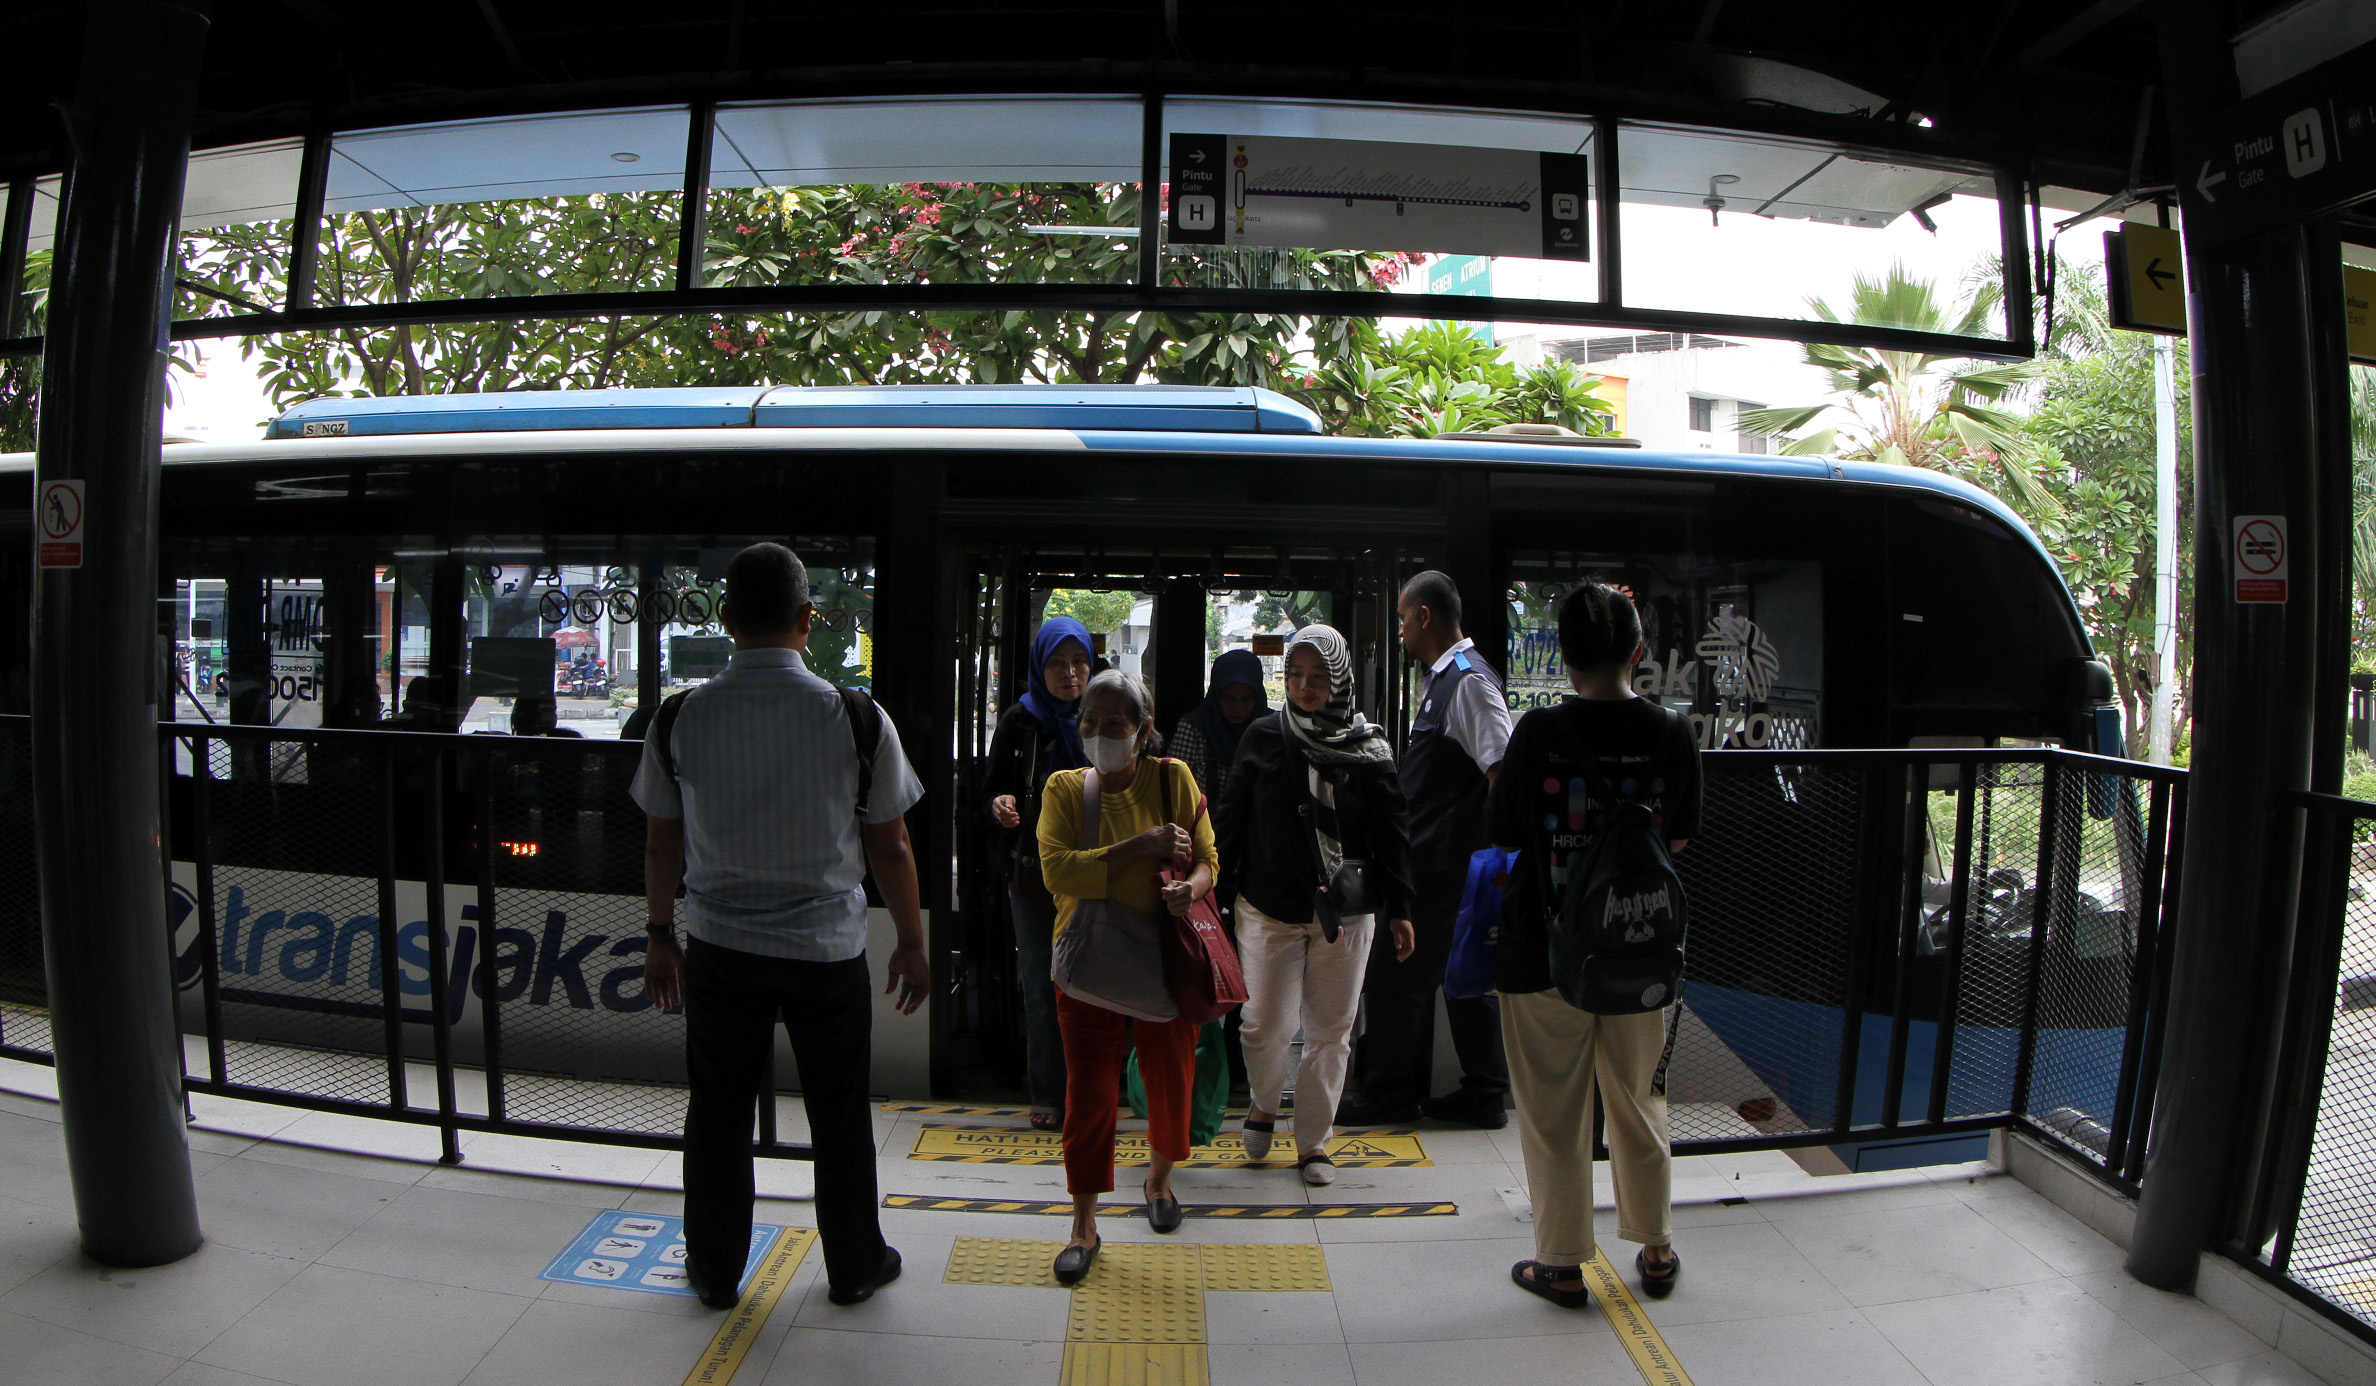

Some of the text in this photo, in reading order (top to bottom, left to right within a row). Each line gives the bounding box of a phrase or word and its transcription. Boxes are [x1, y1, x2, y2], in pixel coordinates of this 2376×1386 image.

[2233, 136, 2274, 164] Pintu
[2293, 123, 2315, 162] H
[1182, 169, 1213, 181] Pintu
[1182, 182, 1203, 192] Gate
[2237, 168, 2265, 189] Gate
[1190, 203, 1204, 221] H
[1460, 256, 1486, 284] ATRIUM
[2346, 296, 2369, 309] eluar
[2348, 311, 2366, 326] Exit
[306, 423, 346, 435] SNGZ
[1633, 648, 1697, 696] ak
[1688, 699, 1772, 750] gko
[698, 1237, 802, 1384] Jalur Antrean Dahulukan Pelanggan Turun!
[1592, 1265, 1684, 1386] alur Antrean Dahulukan Pelanggan
